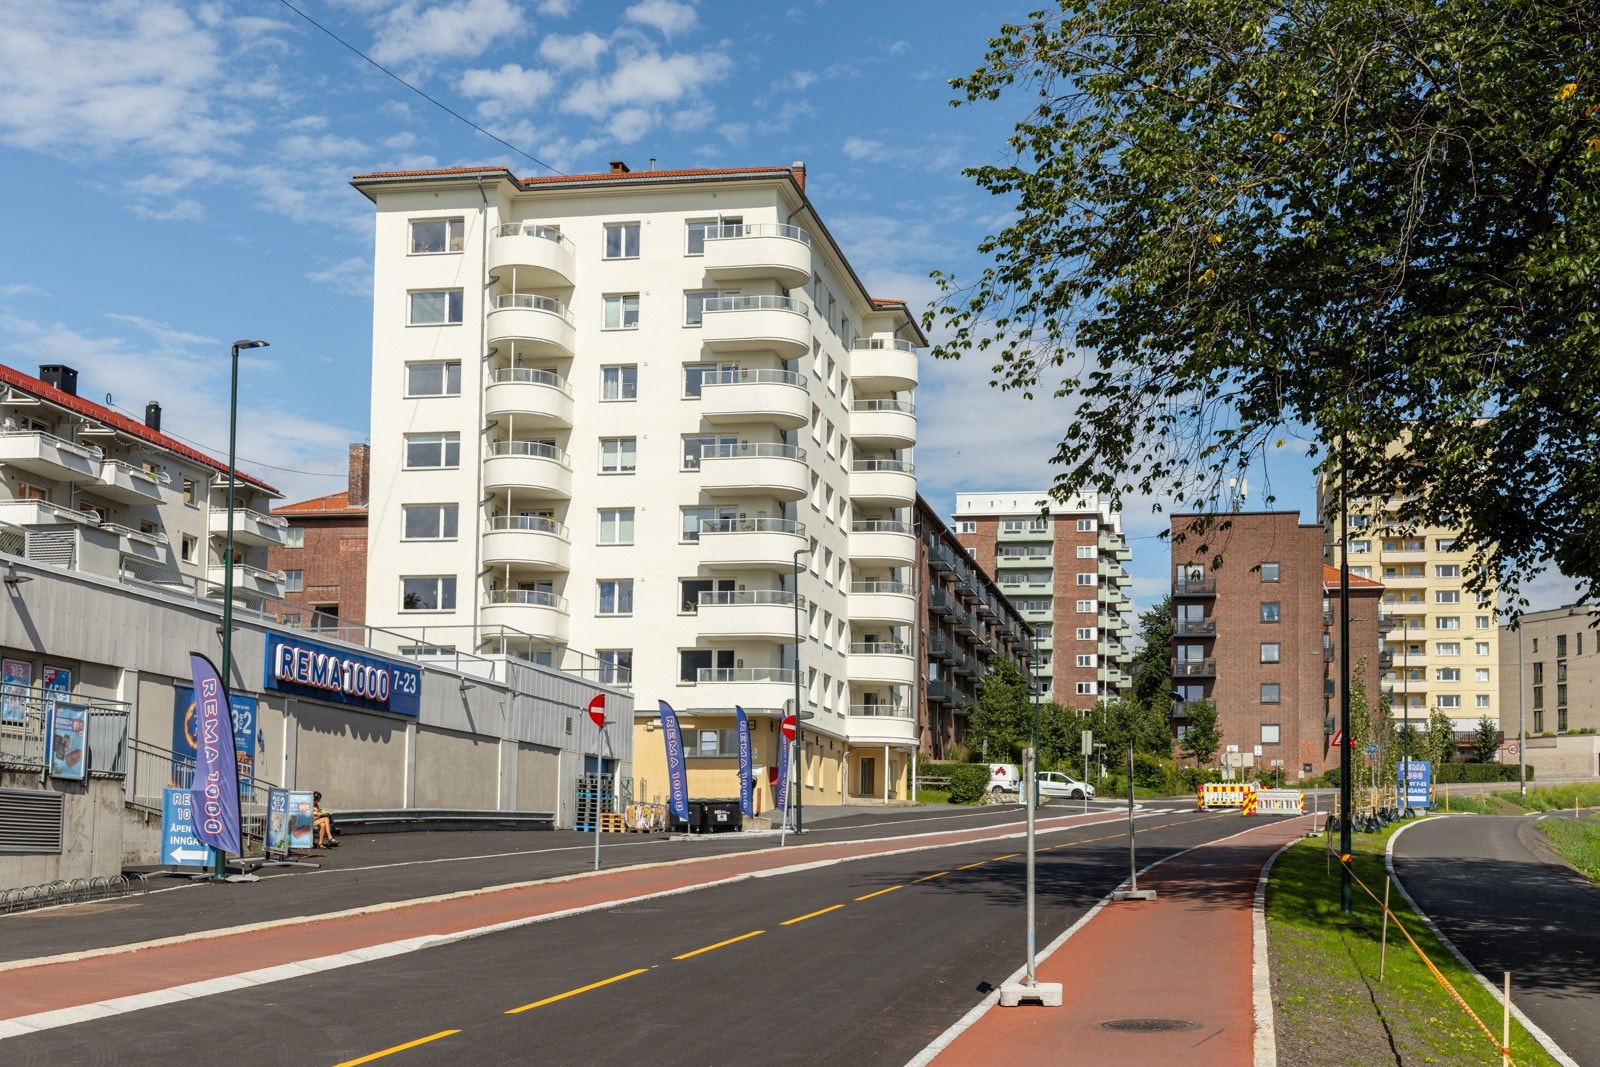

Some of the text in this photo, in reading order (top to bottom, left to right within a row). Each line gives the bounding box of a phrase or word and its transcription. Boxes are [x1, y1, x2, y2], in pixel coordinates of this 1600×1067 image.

[275, 643, 416, 702] REMA 1000 7-23
[231, 709, 239, 734] 3
[243, 711, 252, 734] 2
[202, 677, 224, 835] REMA 1000
[665, 715, 684, 812] REMA 1000
[739, 720, 749, 809] REMA 1000
[1402, 772, 1424, 780] 000
[173, 793, 191, 806] RE
[271, 796, 277, 810] 3
[279, 797, 286, 812] 2
[177, 808, 191, 820] 10
[170, 822, 191, 832] ÅPEN
[170, 836, 207, 846] INNGA
